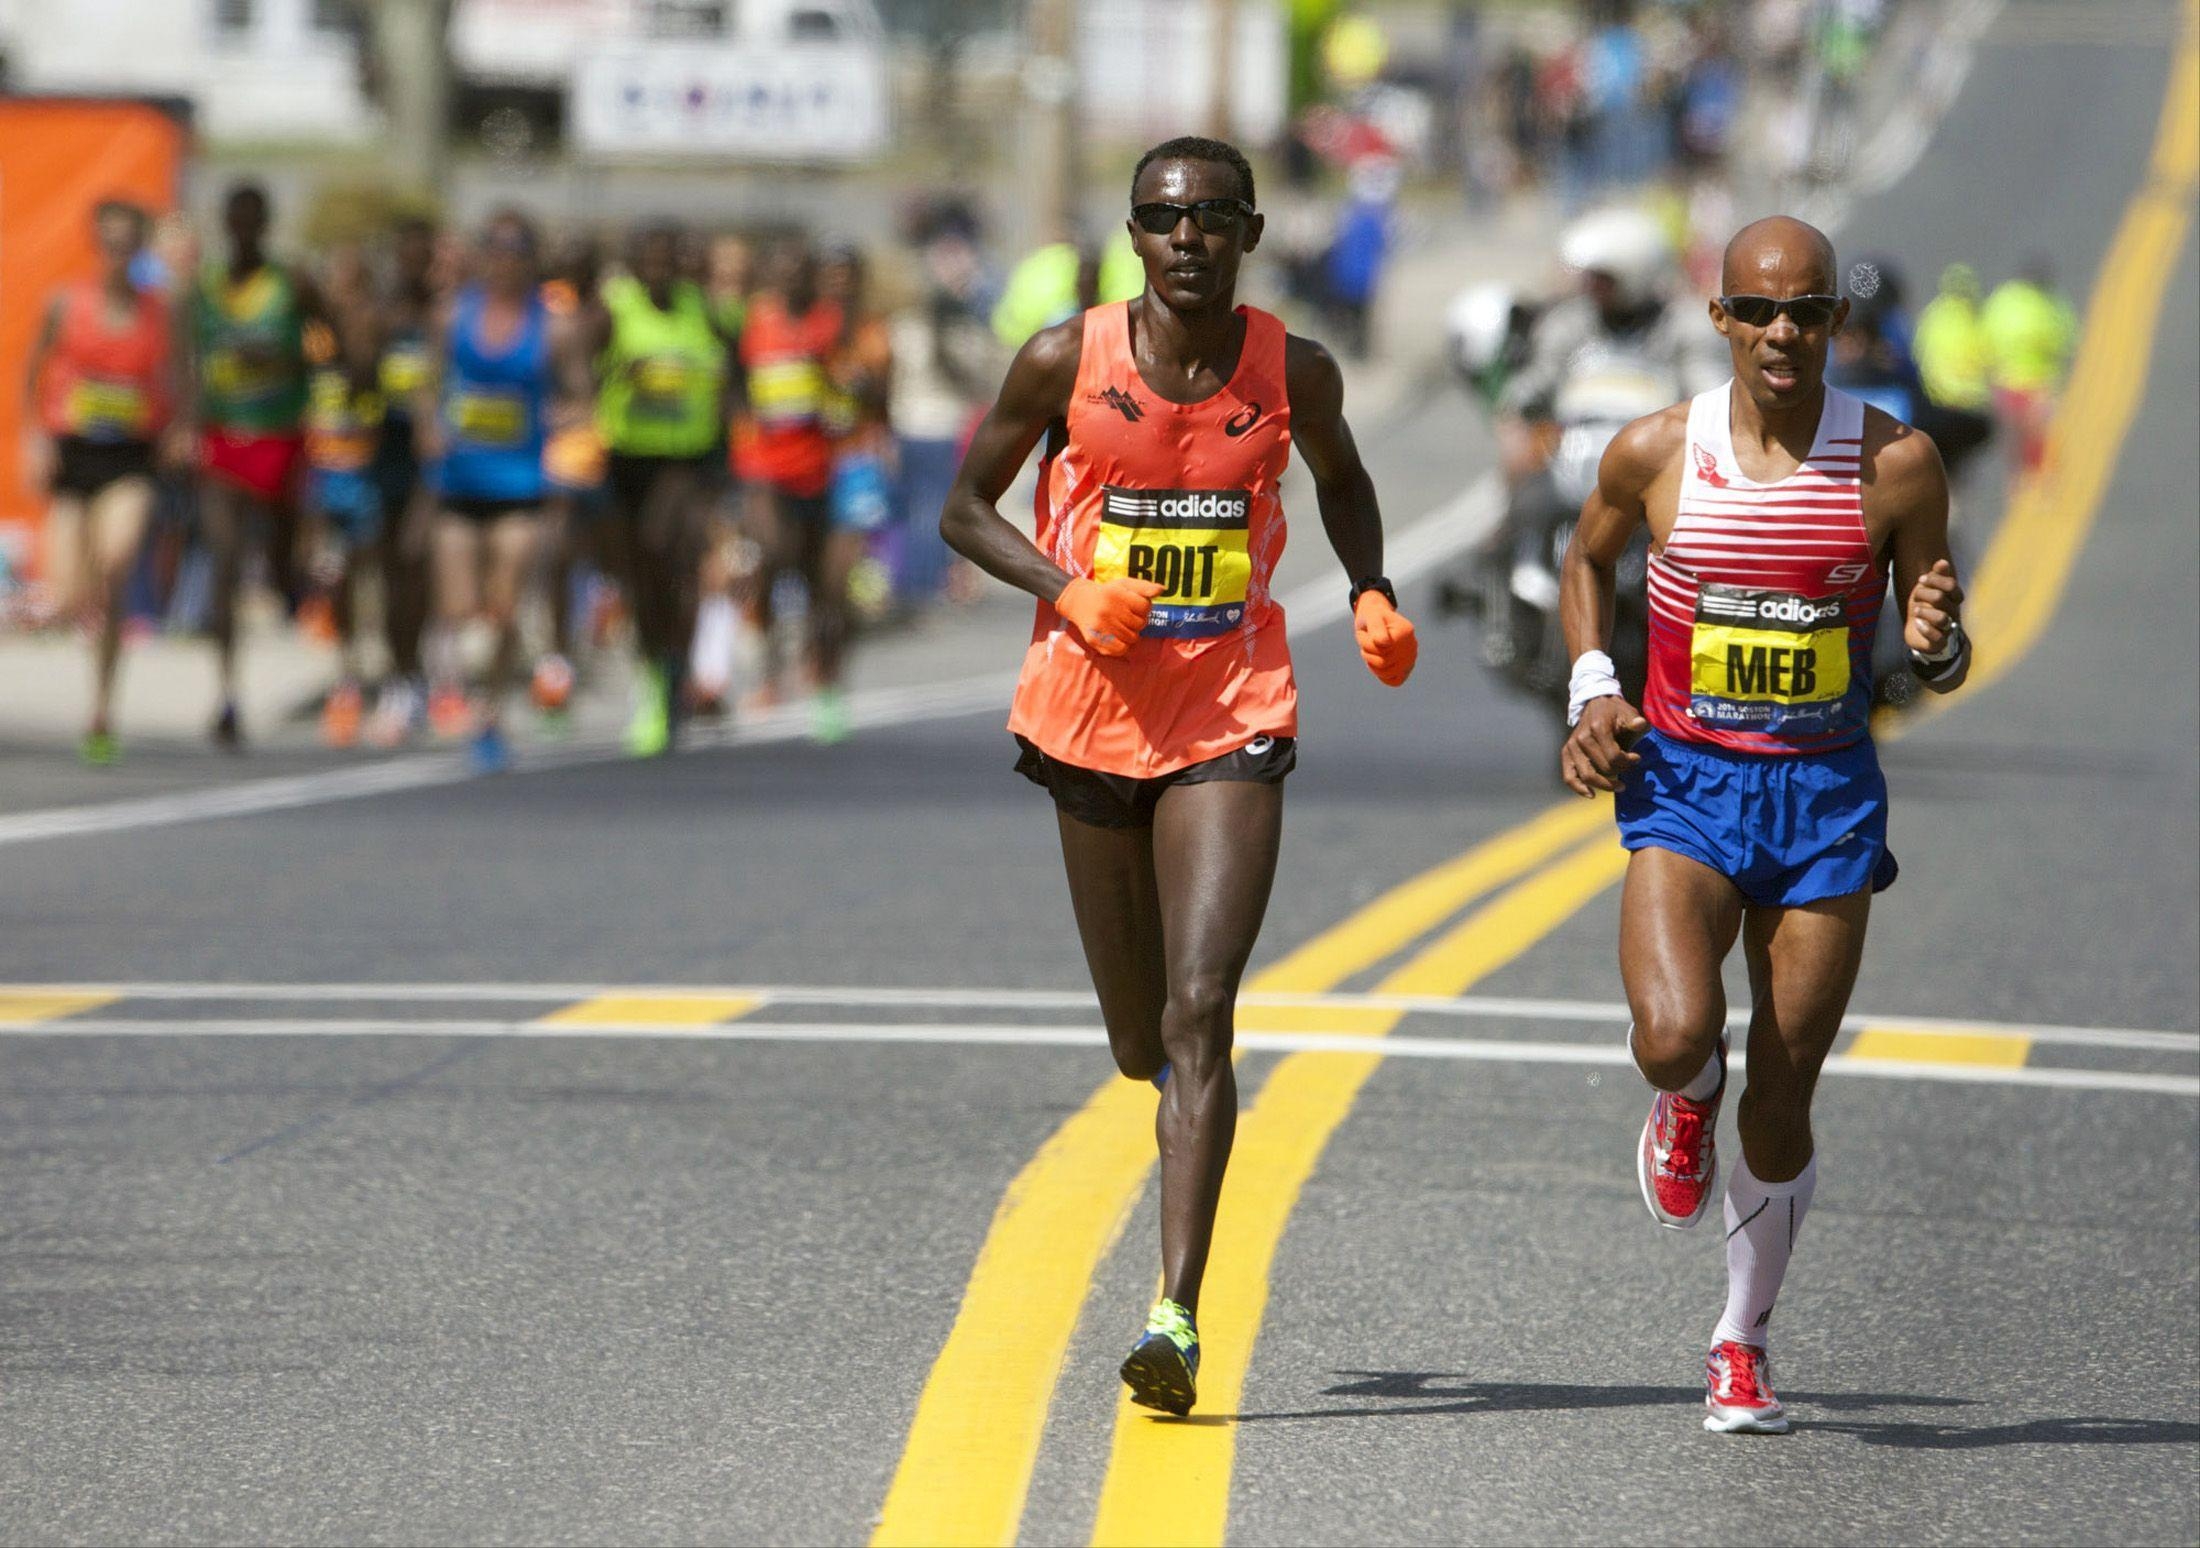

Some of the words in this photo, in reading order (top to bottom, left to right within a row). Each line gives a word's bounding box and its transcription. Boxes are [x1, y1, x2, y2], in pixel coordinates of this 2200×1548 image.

[1160, 495, 1245, 517] adidas
[1727, 643, 1816, 696] MEB
[1717, 711, 1770, 720] MARATHON
